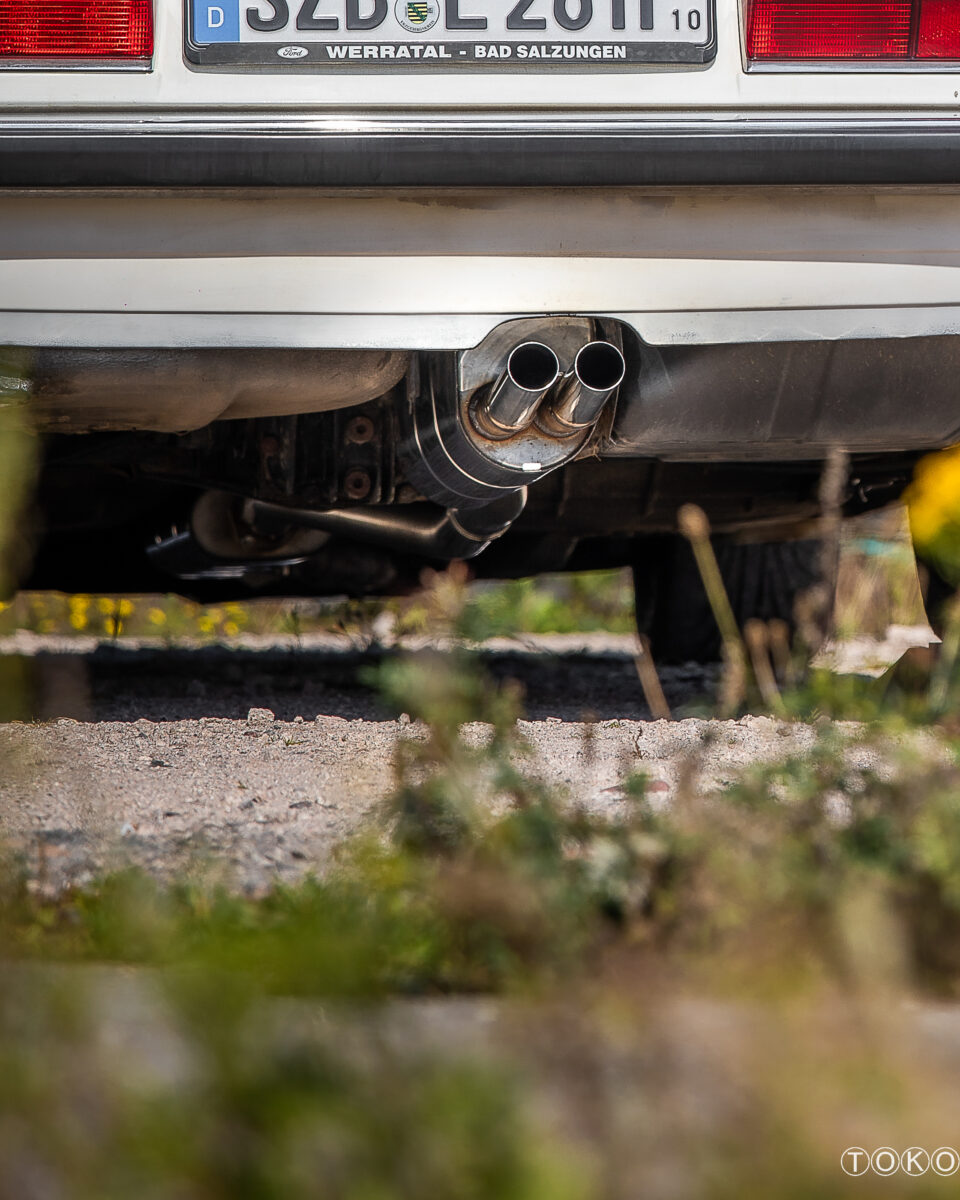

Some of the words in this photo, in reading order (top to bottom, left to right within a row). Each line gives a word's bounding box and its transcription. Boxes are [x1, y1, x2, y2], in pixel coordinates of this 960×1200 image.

[207, 6, 225, 28] D
[672, 8, 700, 31] 10
[326, 45, 452, 59] WERRATAL
[474, 45, 512, 59] BAD
[516, 45, 627, 59] SALZUNGEN
